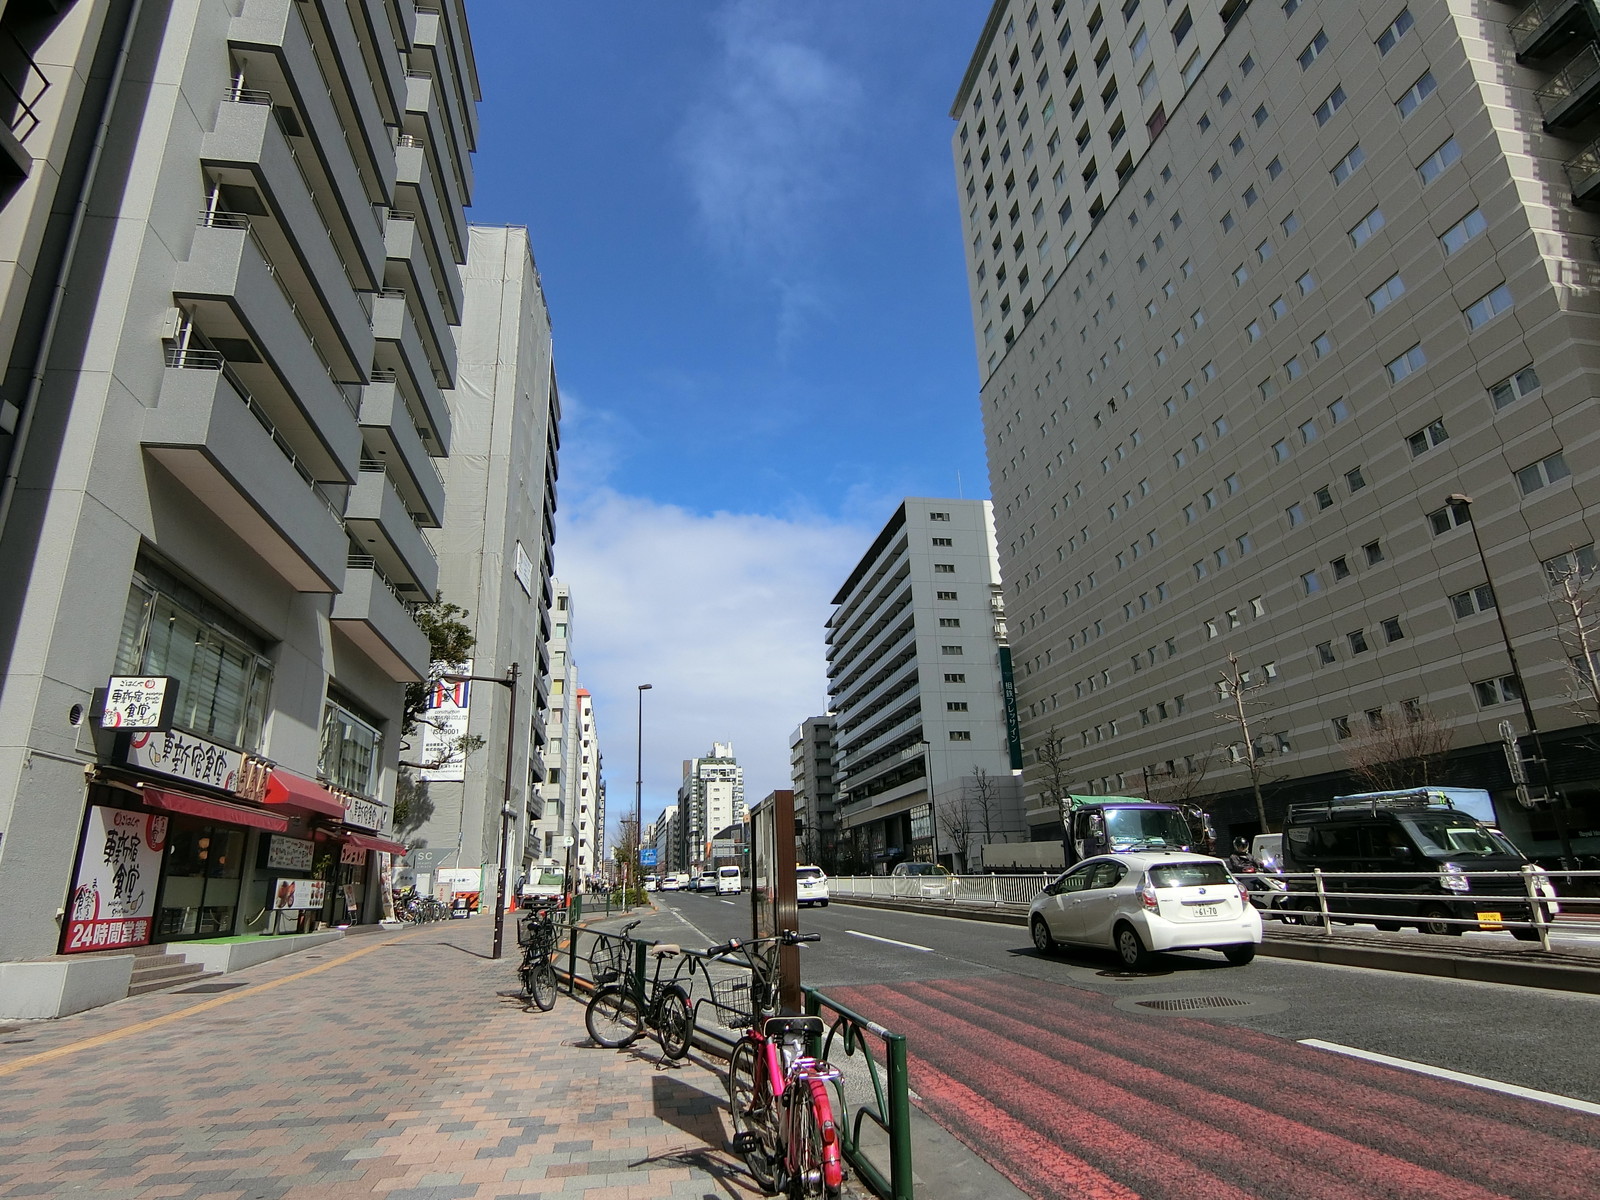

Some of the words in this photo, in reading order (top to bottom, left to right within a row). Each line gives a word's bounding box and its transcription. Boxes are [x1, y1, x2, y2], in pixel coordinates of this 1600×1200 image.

[1198, 907, 1218, 915] 61-70
[70, 919, 148, 949] 24時間営業
